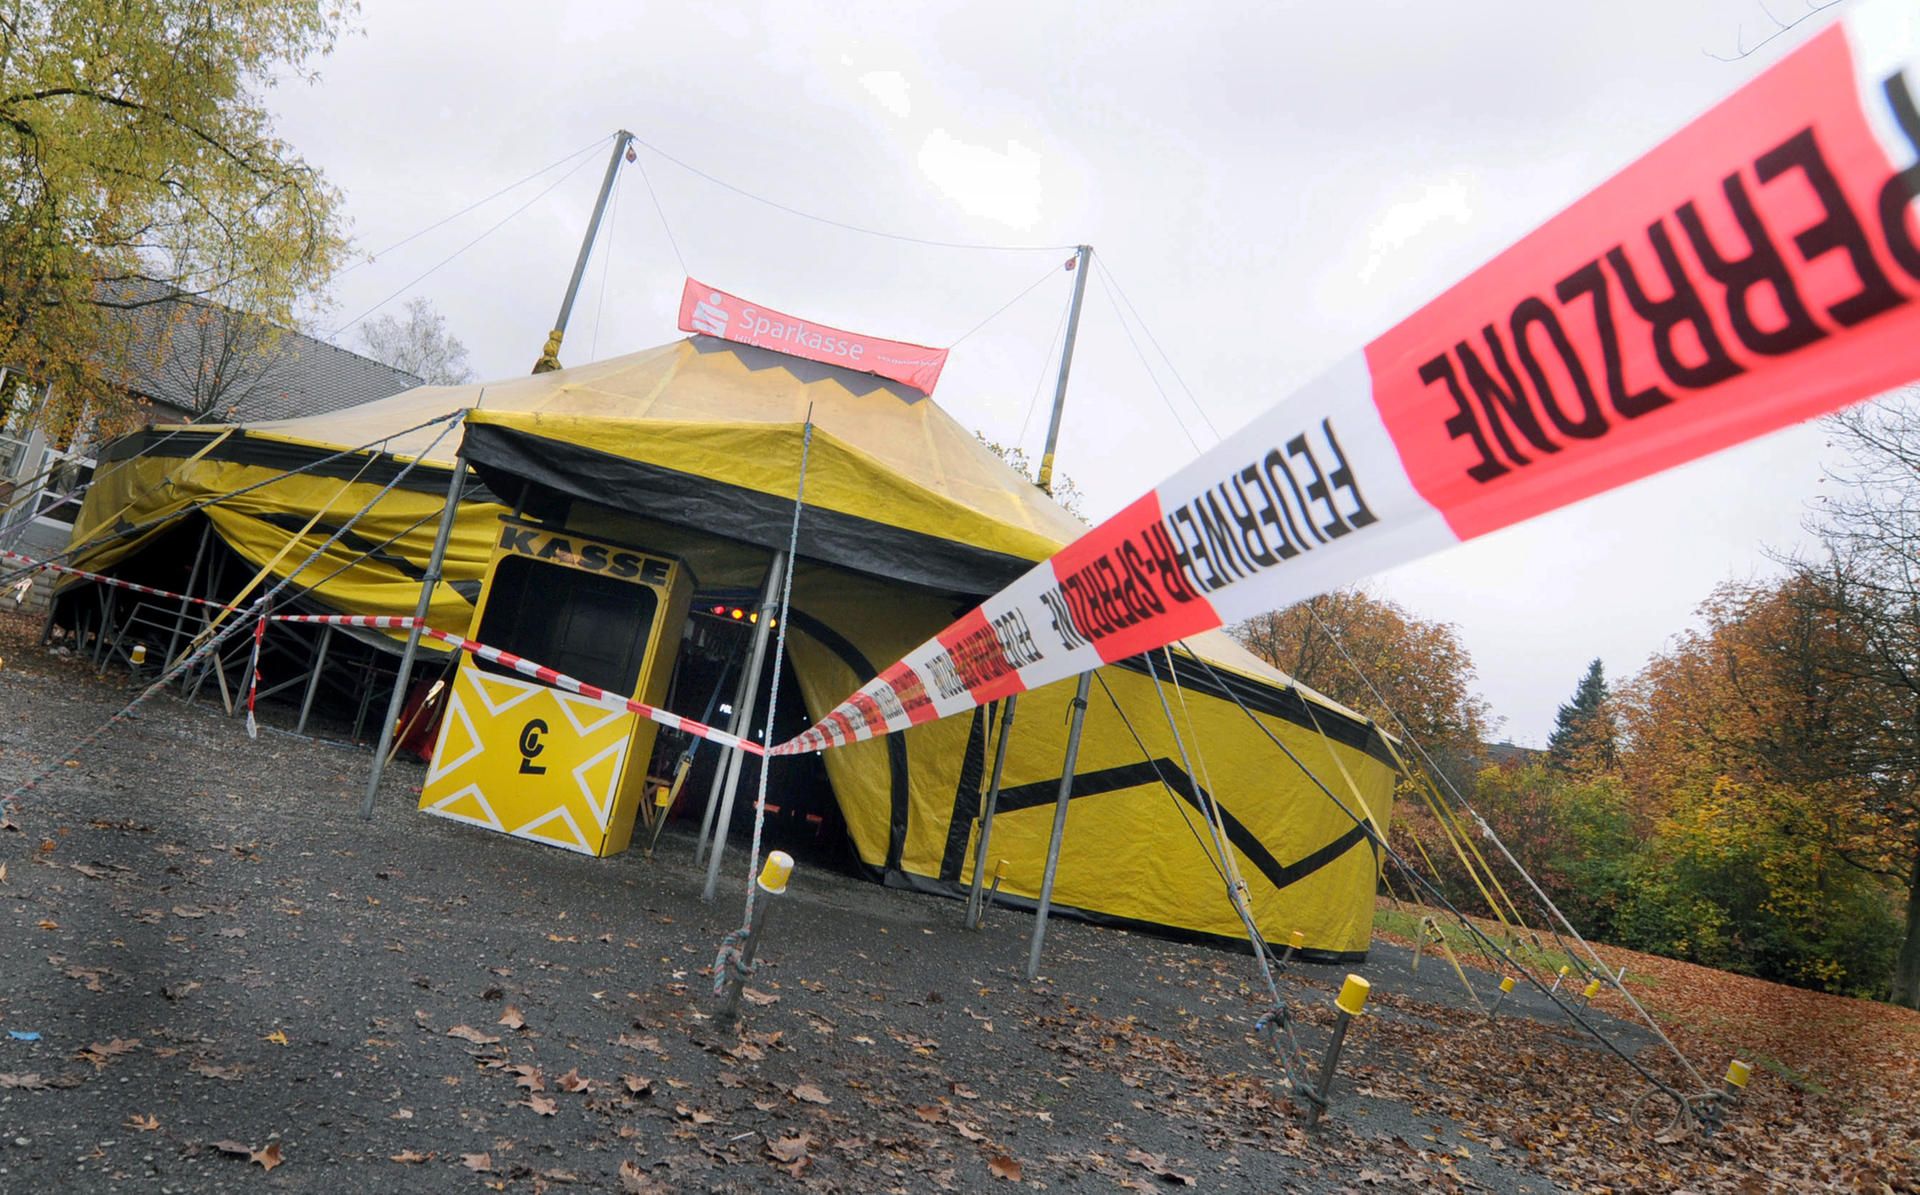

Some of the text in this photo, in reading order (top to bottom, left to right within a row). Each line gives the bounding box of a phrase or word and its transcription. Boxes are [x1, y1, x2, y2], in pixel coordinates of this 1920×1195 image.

[738, 307, 865, 361] Sparkasse
[499, 526, 671, 586] KASSE
[1040, 417, 1379, 651] FEUERWEHR-SPERRZONE
